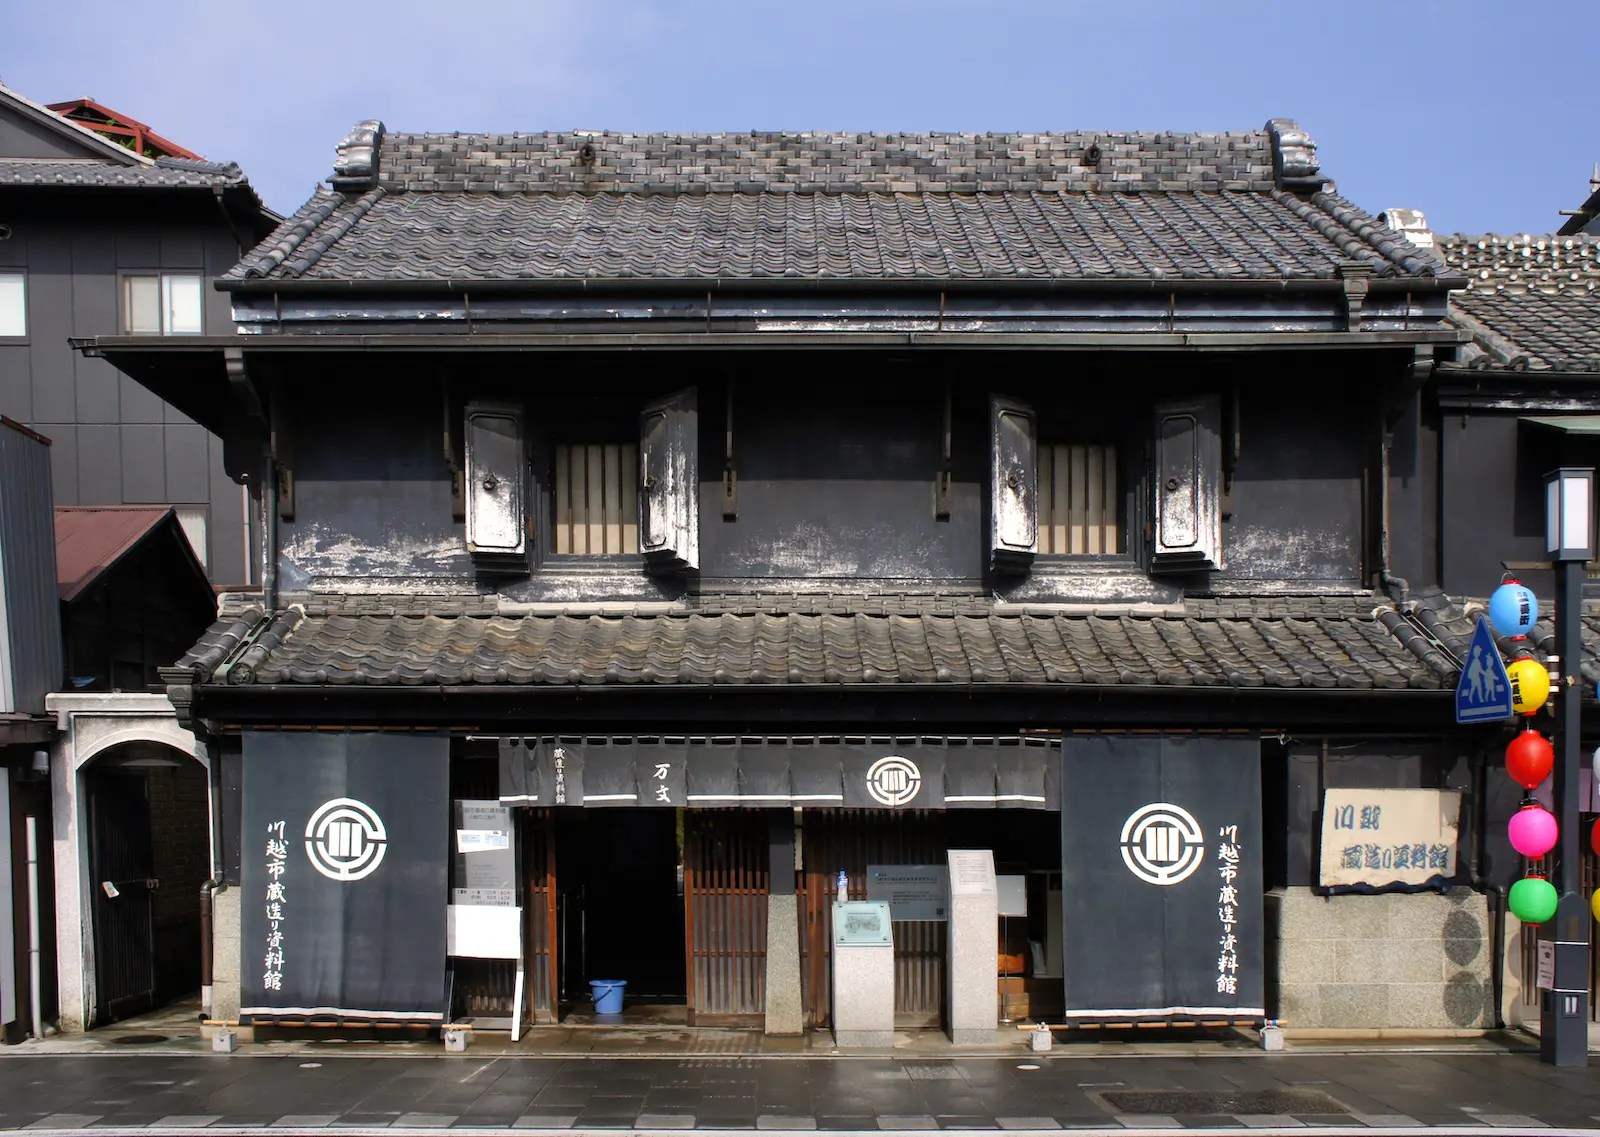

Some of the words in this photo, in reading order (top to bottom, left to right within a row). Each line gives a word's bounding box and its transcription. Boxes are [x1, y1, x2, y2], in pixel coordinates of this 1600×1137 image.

[553, 747, 566, 804] 蔵造り資料館
[652, 762, 671, 803] 万文
[1339, 843, 1449, 870] 蔵造り資料館
[263, 820, 289, 991] 川越市蔵造り資料館
[1216, 824, 1242, 995] 川越市蔵造り資料館
